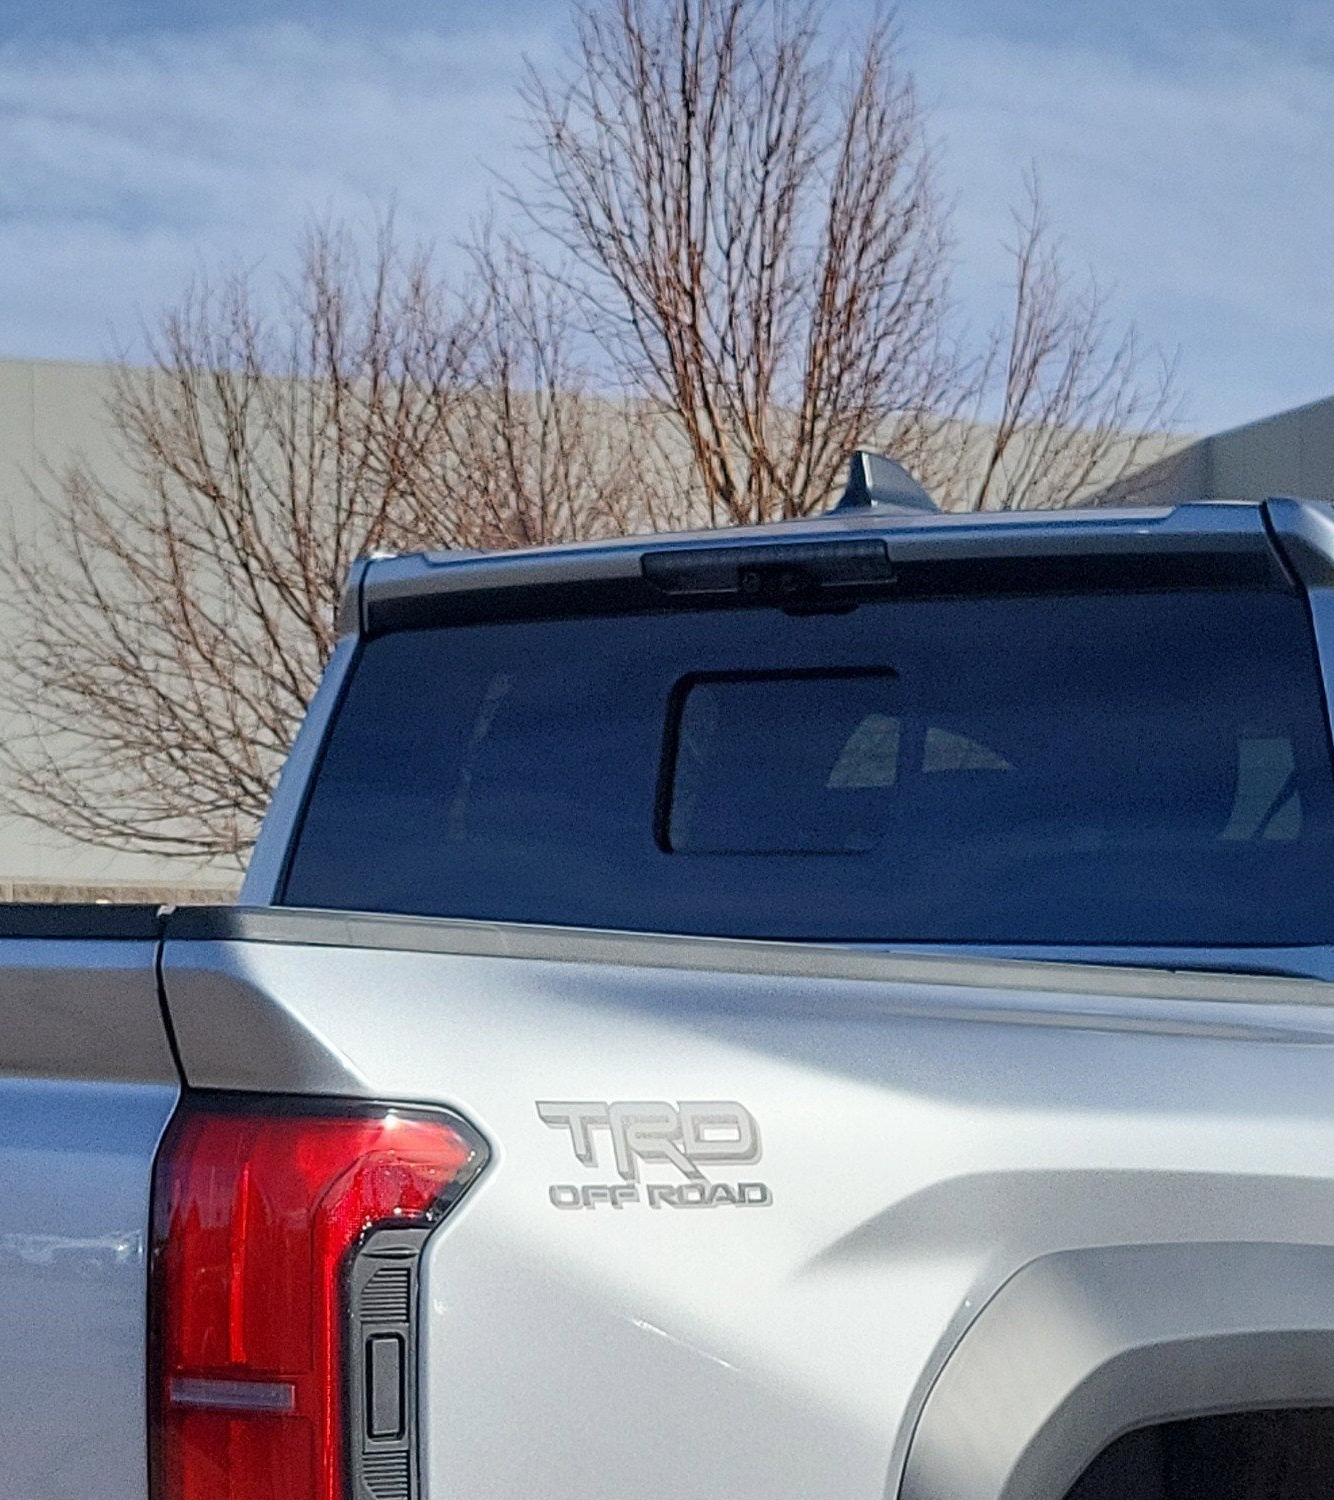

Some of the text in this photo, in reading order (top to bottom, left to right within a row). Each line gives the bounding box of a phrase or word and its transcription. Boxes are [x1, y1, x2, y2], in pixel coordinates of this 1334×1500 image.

[535, 1100, 763, 1183] TRD
[549, 1182, 773, 1210] OFF ROAD
